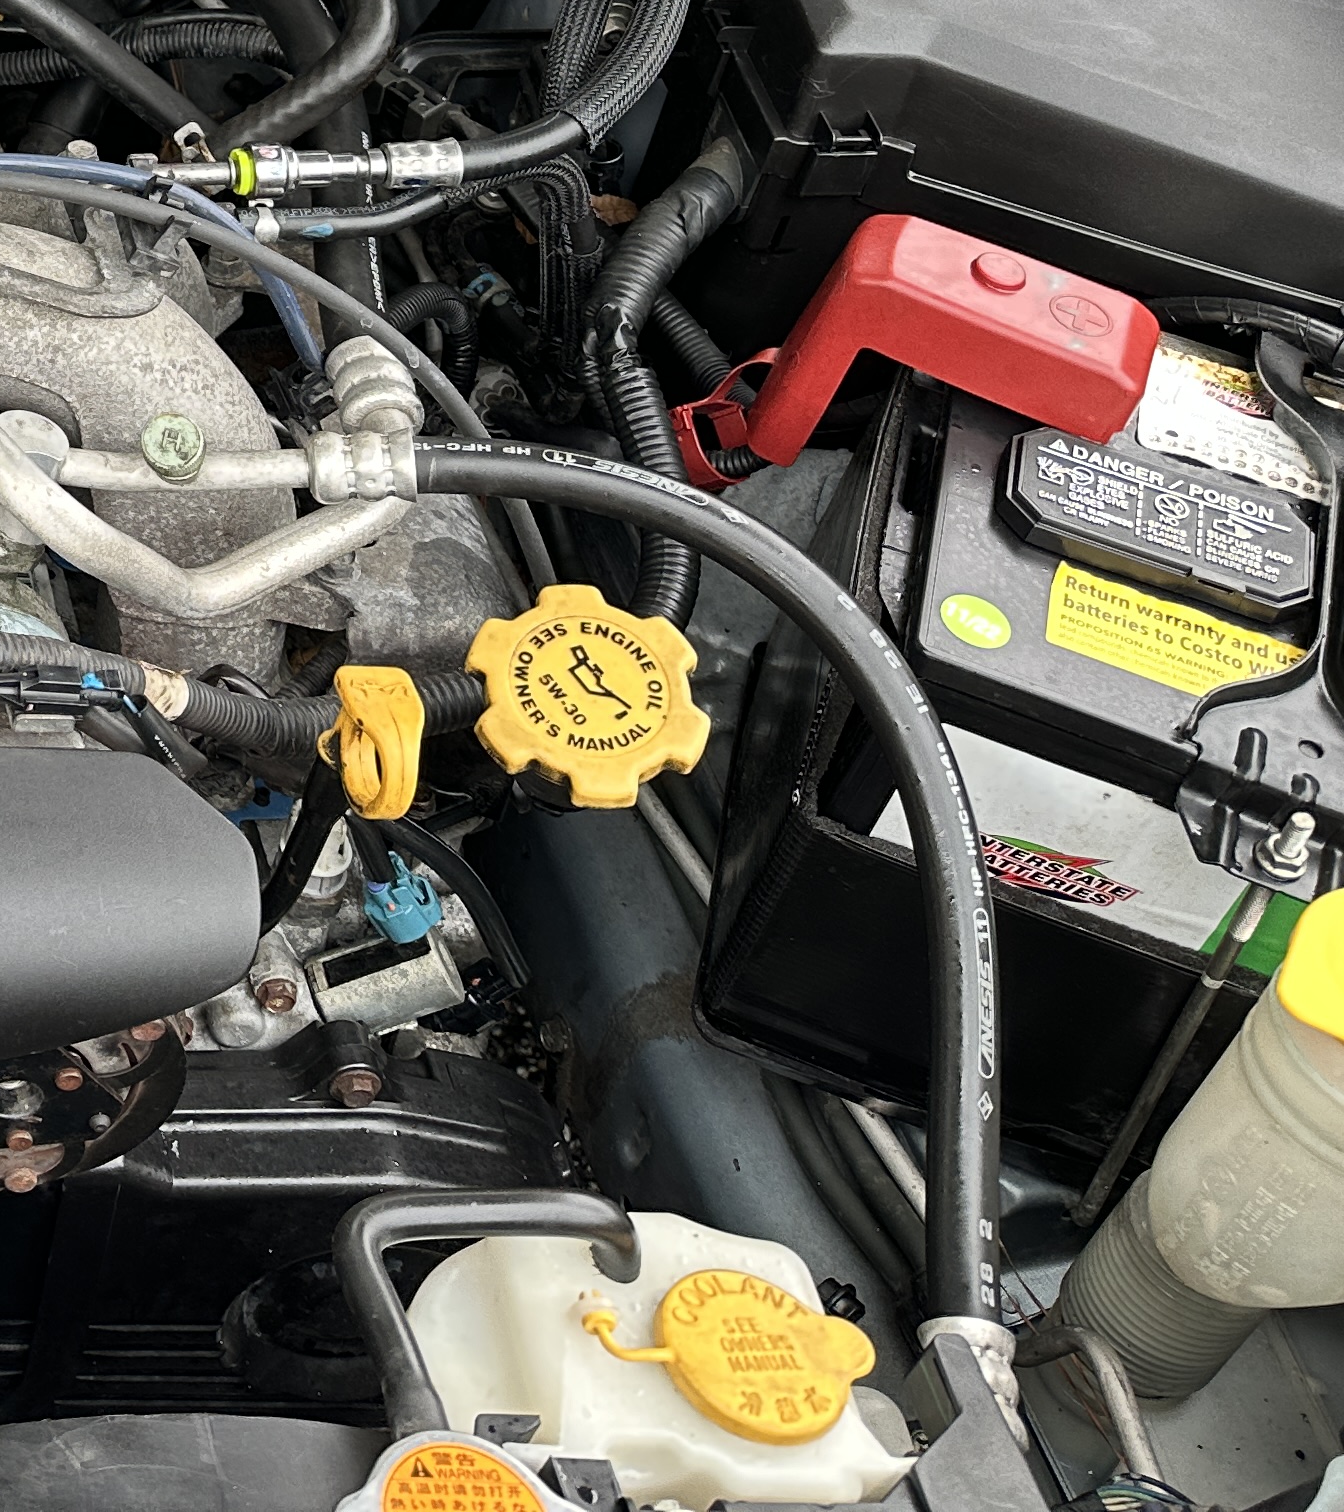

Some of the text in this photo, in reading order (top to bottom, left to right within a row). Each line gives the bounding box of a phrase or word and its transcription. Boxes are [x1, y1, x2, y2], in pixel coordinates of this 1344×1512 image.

[1073, 445, 1165, 486] DANGER
[1188, 483, 1274, 521] POISON
[1097, 476, 1139, 495] SHIELD
[1159, 514, 1180, 526] NO
[1205, 538, 1263, 563] CAN CAUSE
[1206, 529, 1294, 565] SULFURIC ACID
[837, 591, 858, 612] 2
[945, 601, 1002, 642] 11/22
[1064, 574, 1130, 610] Return
[1135, 601, 1226, 646] warranty
[1230, 630, 1271, 658] and
[869, 628, 902, 669] 28
[1060, 614, 1144, 650] PROPOSITION
[1146, 645, 1161, 656] 65
[1063, 593, 1149, 637] batteries
[1154, 625, 1175, 645] to
[1180, 637, 1244, 671] Costco
[514, 623, 652, 751] SEE OWNER'S MANUAL
[579, 621, 664, 712] ENGINE OIL
[538, 673, 587, 726] 5W-30
[971, 867, 984, 897] HP
[979, 834, 1133, 899] NTERSTATE
[983, 853, 1112, 906] ATTERIES
[672, 1274, 809, 1326] COOLANT
[721, 1317, 762, 1334] SEE
[727, 1354, 804, 1373] MANUAL
[431, 1451, 476, 1467] 警告
[434, 1468, 502, 1482] WARNING
